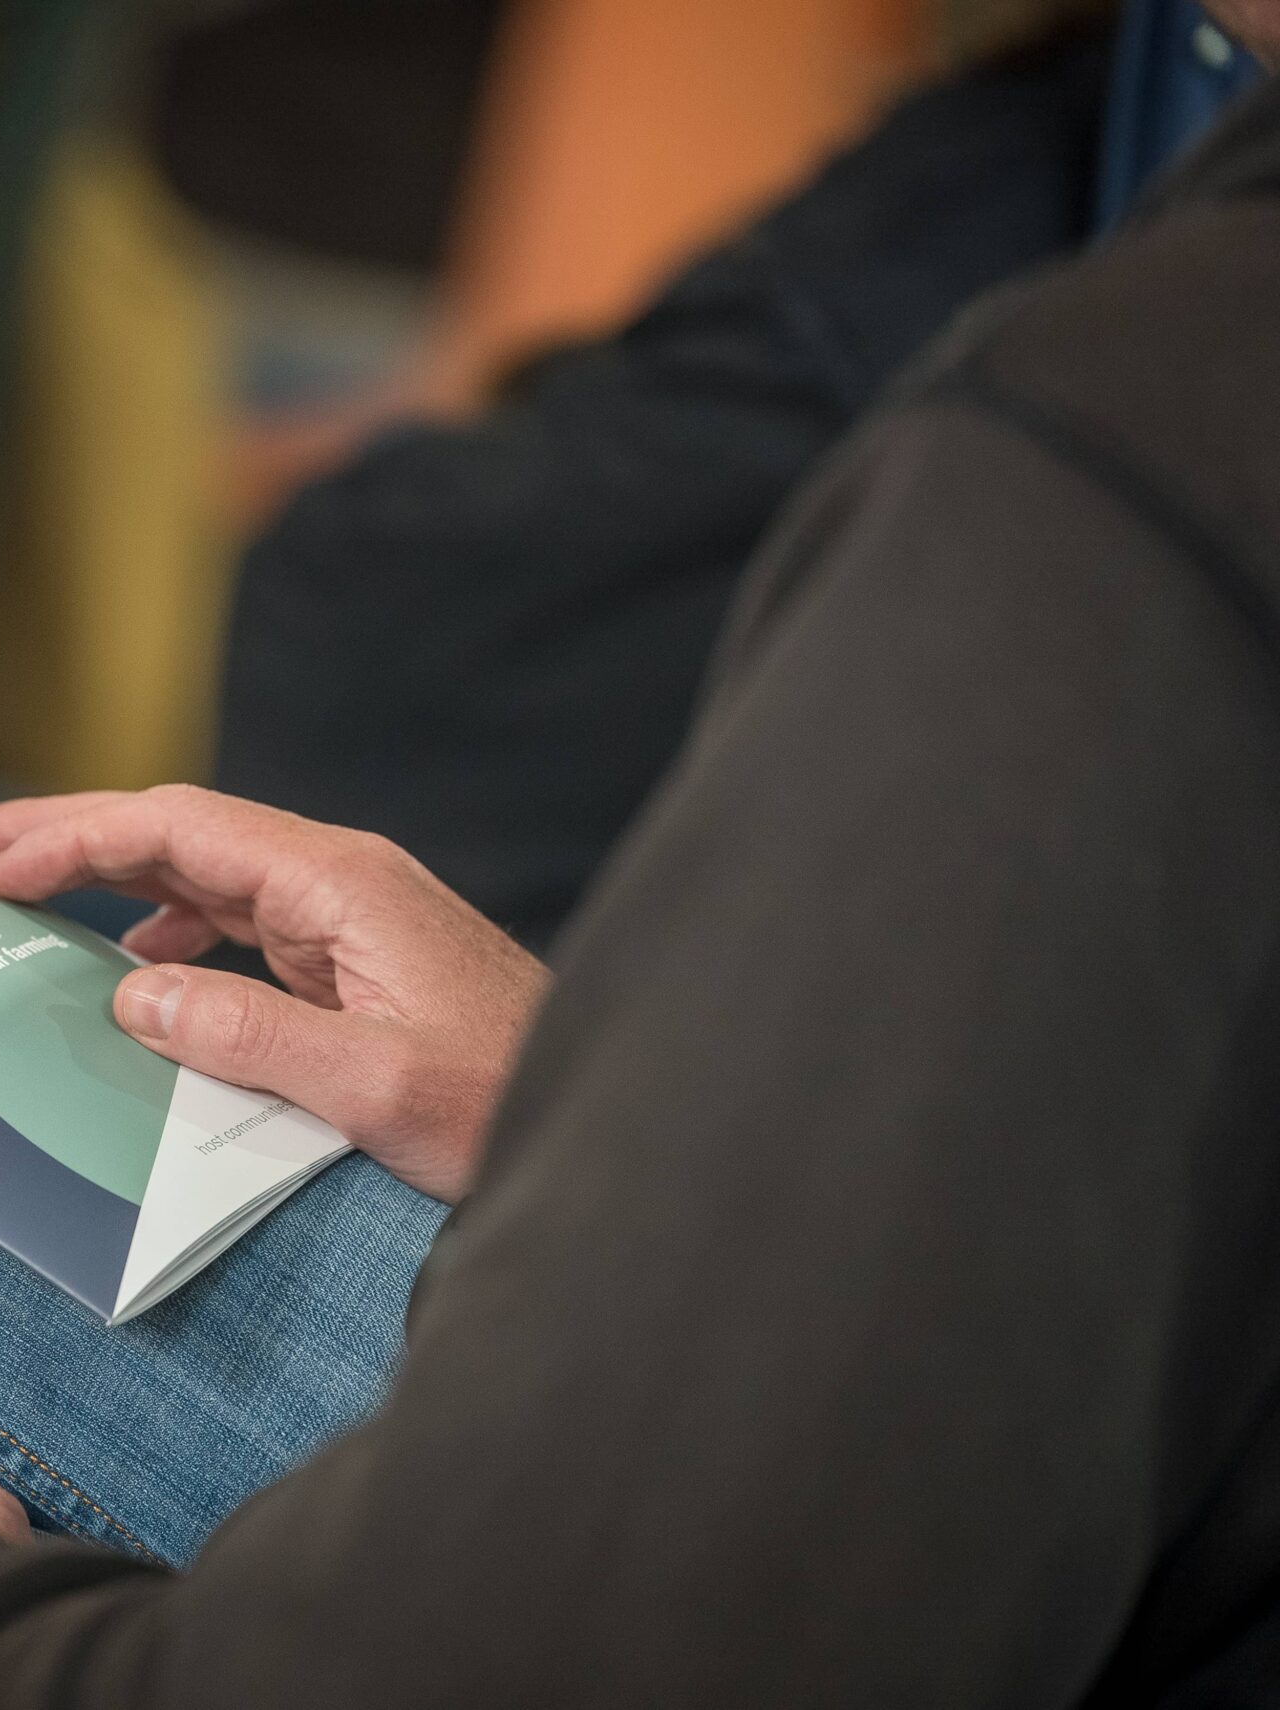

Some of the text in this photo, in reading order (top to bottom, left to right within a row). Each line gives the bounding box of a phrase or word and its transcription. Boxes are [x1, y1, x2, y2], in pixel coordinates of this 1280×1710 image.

[1, 933, 68, 961] farming
[194, 1100, 295, 1156] host communities
